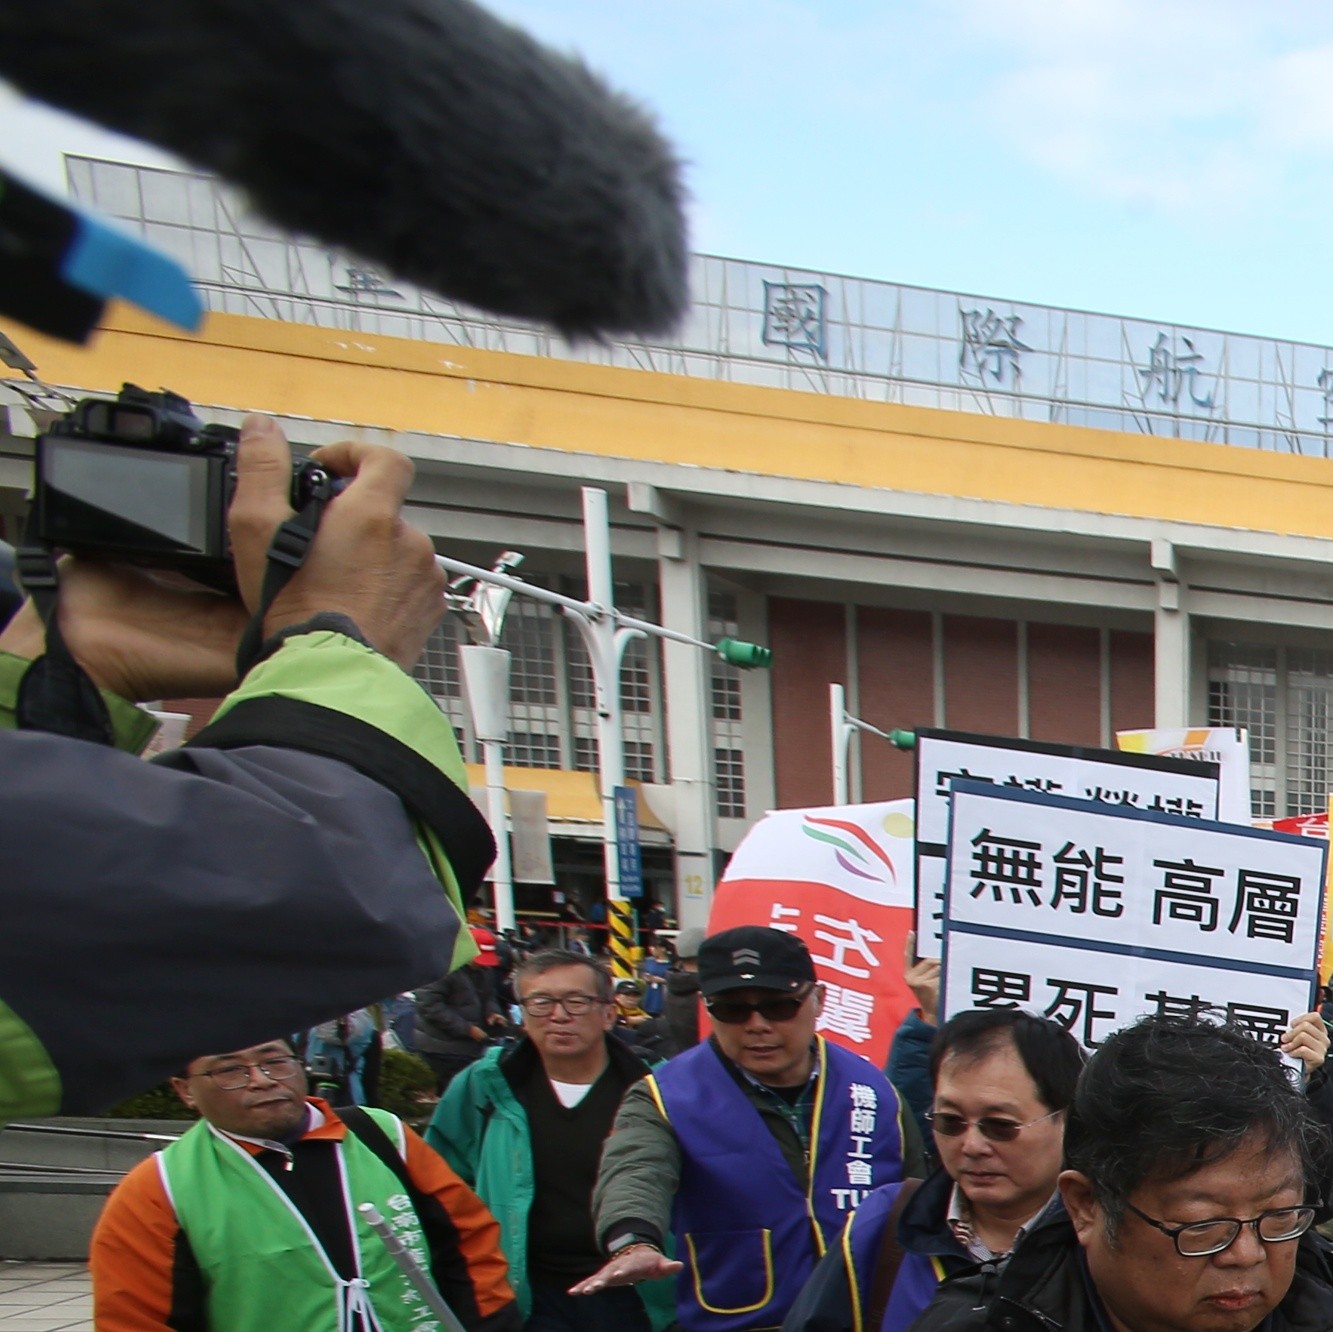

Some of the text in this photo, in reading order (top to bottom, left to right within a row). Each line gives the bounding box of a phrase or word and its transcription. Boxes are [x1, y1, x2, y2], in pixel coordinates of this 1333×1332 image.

[969, 827, 1126, 919] 無能
[1150, 857, 1302, 946] 高層
[848, 1083, 878, 1185] 機師工會
